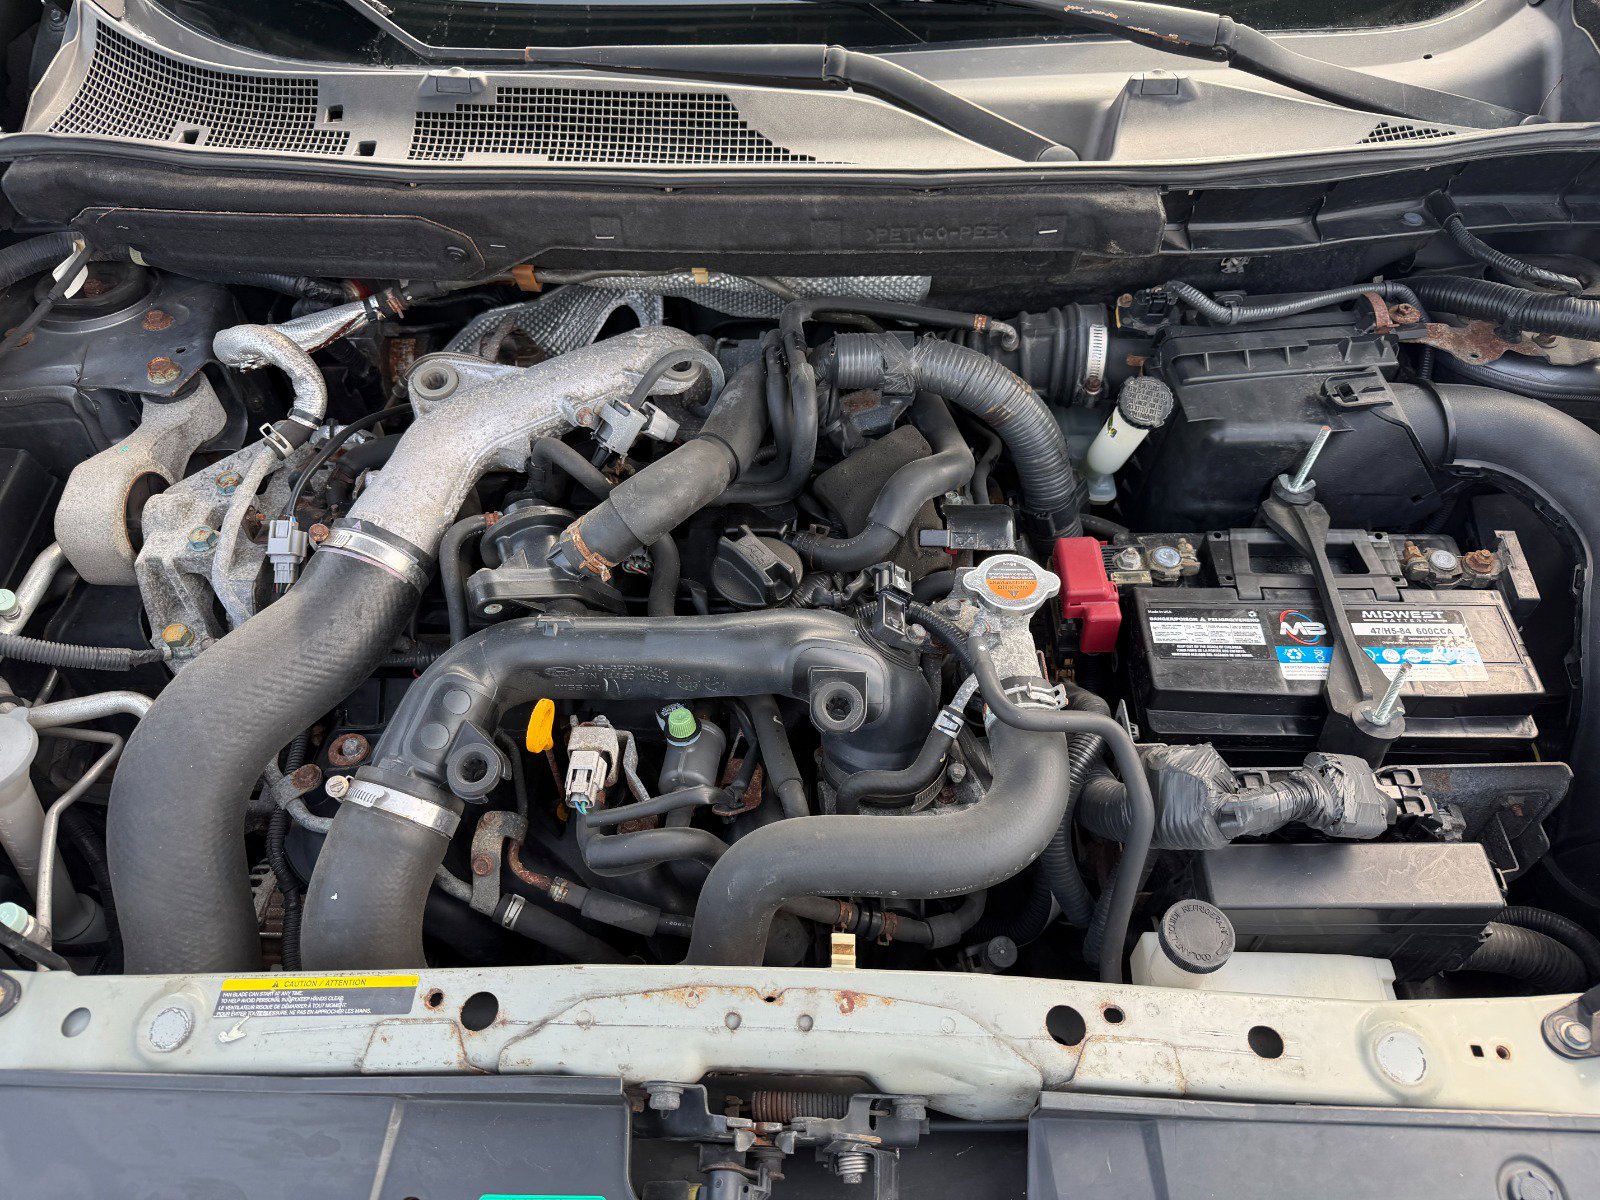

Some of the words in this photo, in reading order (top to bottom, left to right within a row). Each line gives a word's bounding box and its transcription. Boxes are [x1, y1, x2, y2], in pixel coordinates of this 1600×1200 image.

[1361, 610, 1444, 619] MIDWEST
[1370, 627, 1412, 635] 47/H5-84
[1175, 942, 1212, 962] COOLANT
[284, 980, 317, 988] CAUTION
[325, 978, 367, 987] ATTENTION
